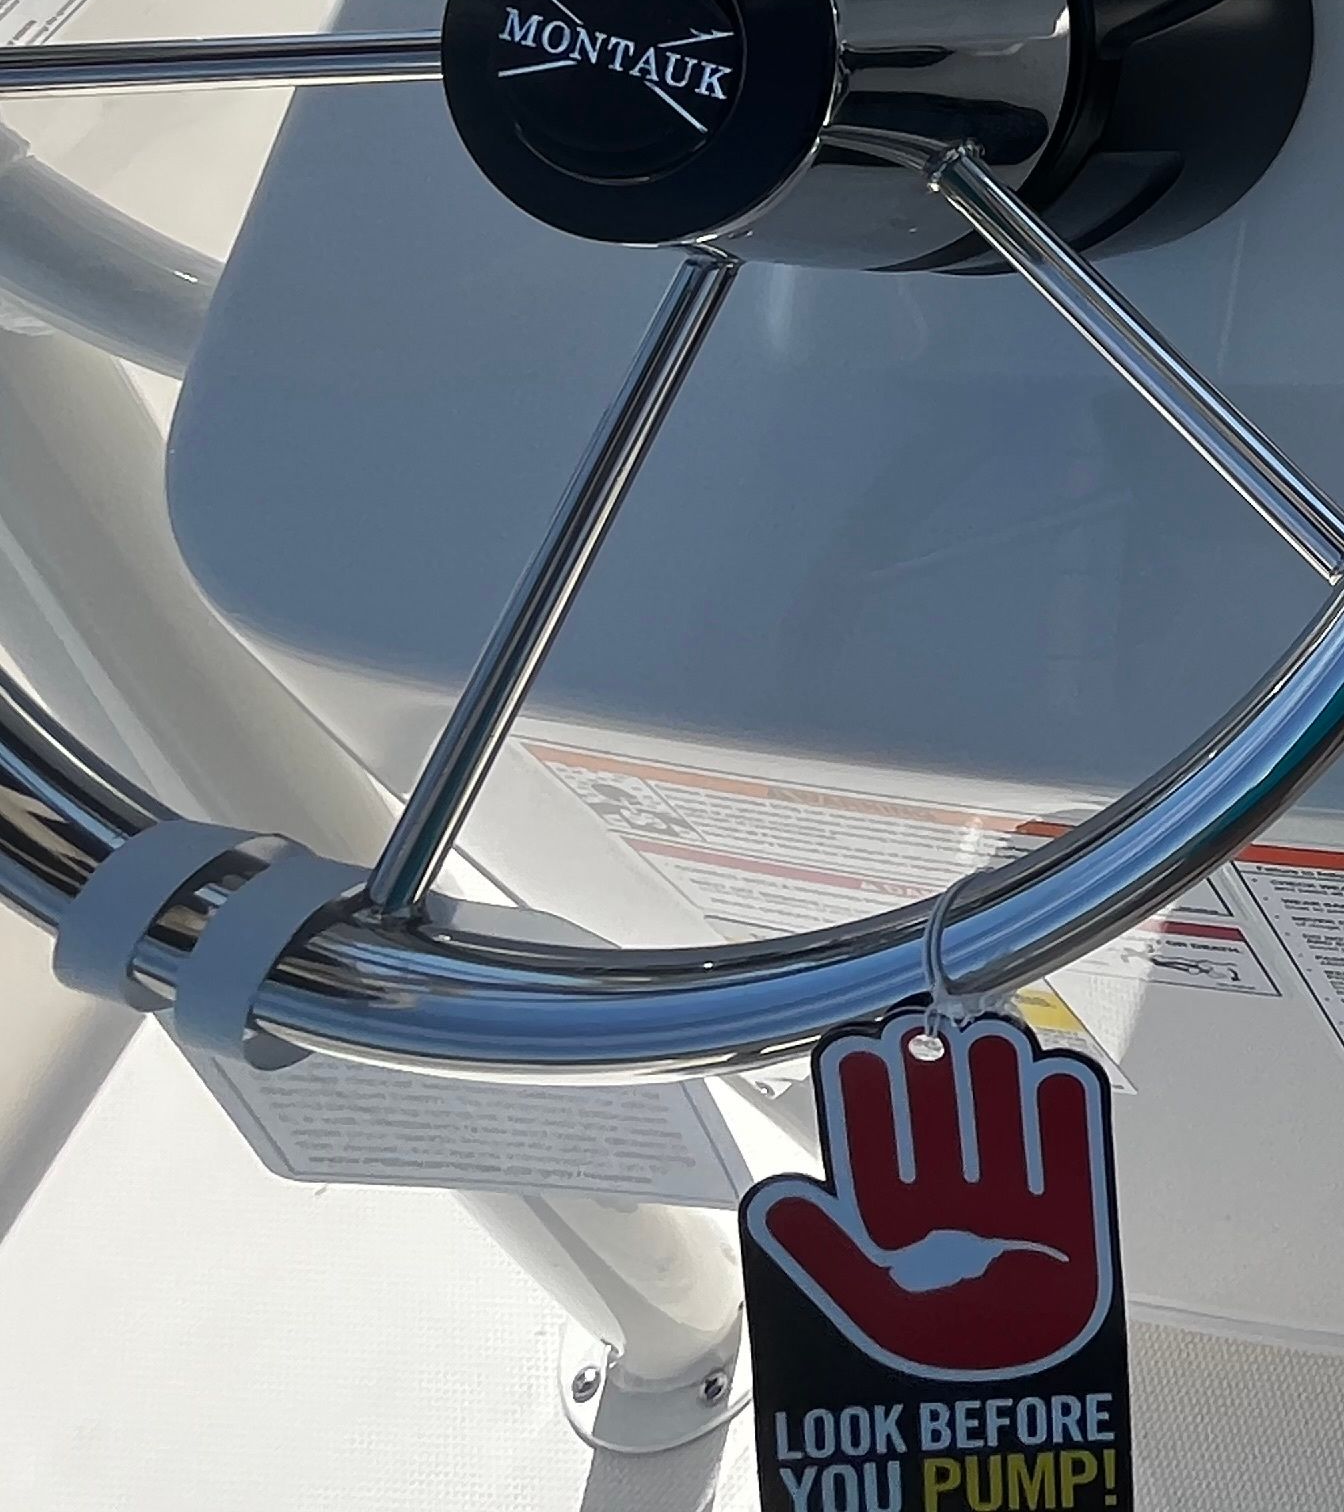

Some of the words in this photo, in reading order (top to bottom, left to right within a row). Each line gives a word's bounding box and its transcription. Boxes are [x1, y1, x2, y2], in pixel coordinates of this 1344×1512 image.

[498, 6, 732, 100] MONTAUK
[774, 1403, 907, 1461] LOOK
[918, 1393, 1116, 1452] BEFORE
[779, 1460, 902, 1512] YOU
[922, 1448, 1117, 1512] PUMP!
